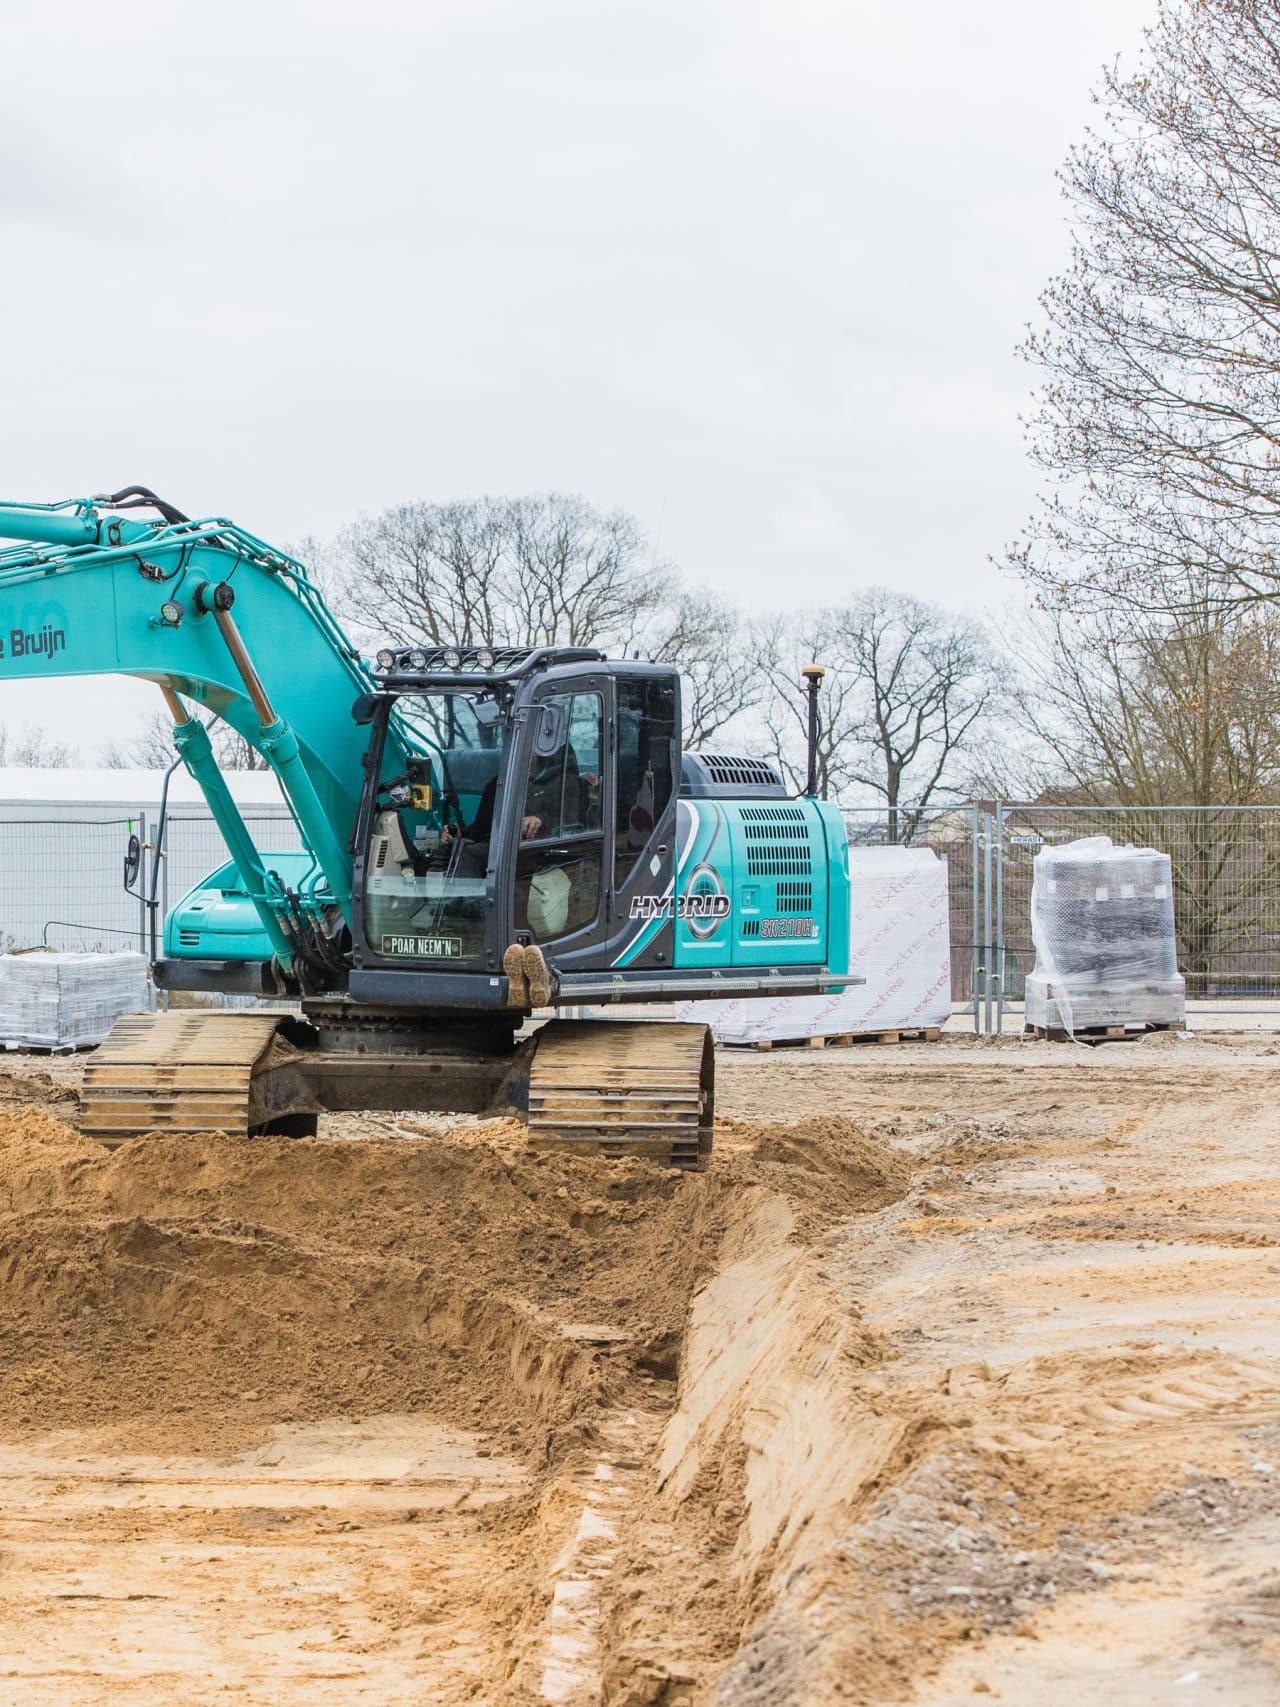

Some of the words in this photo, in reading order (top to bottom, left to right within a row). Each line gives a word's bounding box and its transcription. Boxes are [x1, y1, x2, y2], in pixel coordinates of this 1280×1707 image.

[10, 624, 66, 659] Bruijn
[628, 894, 731, 919] HYBRID
[391, 937, 415, 954] POAR
[417, 939, 452, 956] NEEM'N
